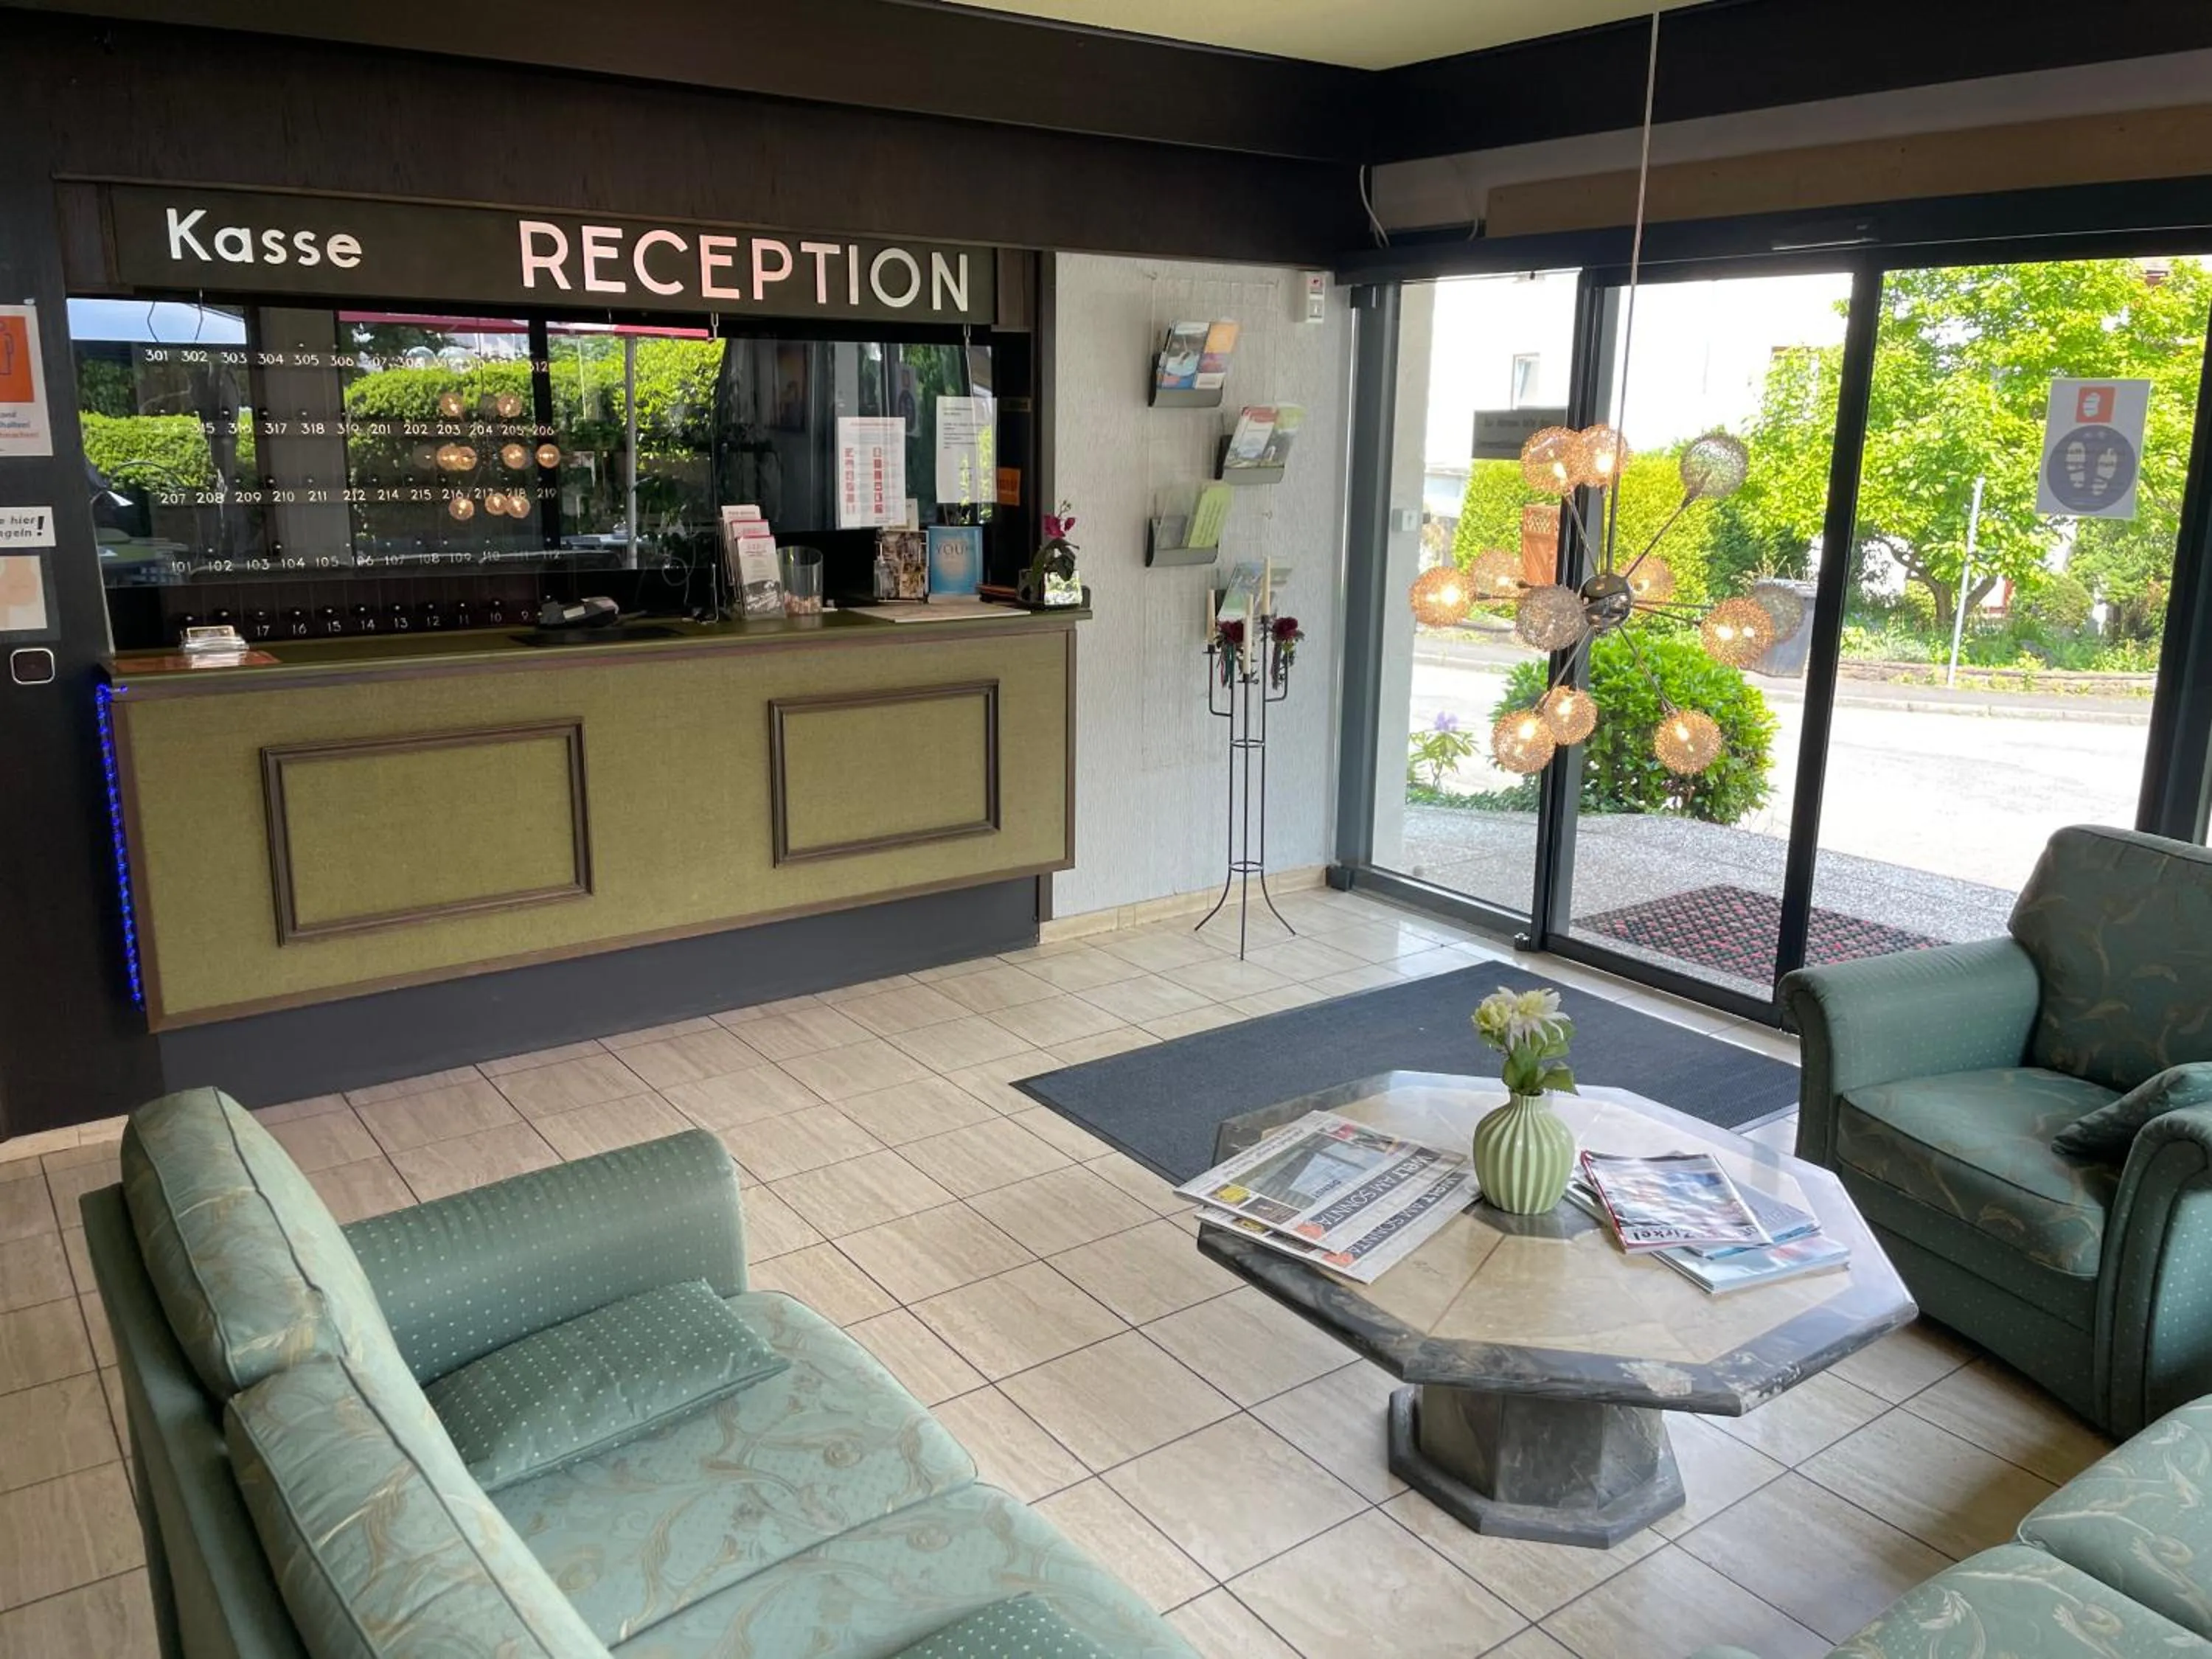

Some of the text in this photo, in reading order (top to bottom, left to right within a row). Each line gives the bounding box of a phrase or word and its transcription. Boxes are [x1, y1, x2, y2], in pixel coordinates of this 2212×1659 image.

[166, 207, 363, 268] Kasse
[518, 220, 969, 313] RECEPTION
[145, 349, 169, 361] 301
[181, 350, 208, 362] 302
[220, 351, 248, 364] 303
[257, 352, 285, 364] 304
[293, 354, 319, 366] 305
[329, 355, 355, 366] 306
[264, 422, 288, 434] 317
[301, 422, 325, 434] 318
[371, 424, 391, 434] 201
[403, 423, 428, 435] 202
[437, 424, 461, 435] 203
[469, 424, 493, 436] 204
[501, 424, 524, 437] 205
[533, 425, 554, 436] 206
[160, 493, 185, 505] 207
[195, 492, 225, 504] 208
[235, 491, 262, 503] 209
[272, 490, 295, 502] 210
[307, 490, 327, 502] 211
[342, 490, 366, 501] 212
[378, 489, 399, 501] 214
[411, 489, 432, 501] 215
[442, 489, 464, 499] 216
[536, 487, 557, 498] 219
[10, 515, 35, 526] hier
[172, 560, 191, 572] 101
[208, 560, 234, 572] 102
[246, 559, 271, 571] 103
[281, 557, 305, 568] 104
[315, 556, 338, 567] 105
[450, 553, 472, 563] 109
[257, 625, 271, 636] 17
[292, 624, 307, 635] 16
[327, 621, 341, 633] 15
[360, 619, 375, 630] 14
[394, 618, 408, 629] 13
[426, 615, 441, 627] 12
[458, 614, 470, 625] 11
[489, 612, 503, 623] 10
[1372, 1175, 1397, 1194] AM
[1316, 1187, 1377, 1227] SONNTA
[1350, 1213, 1406, 1254] SONNTA
